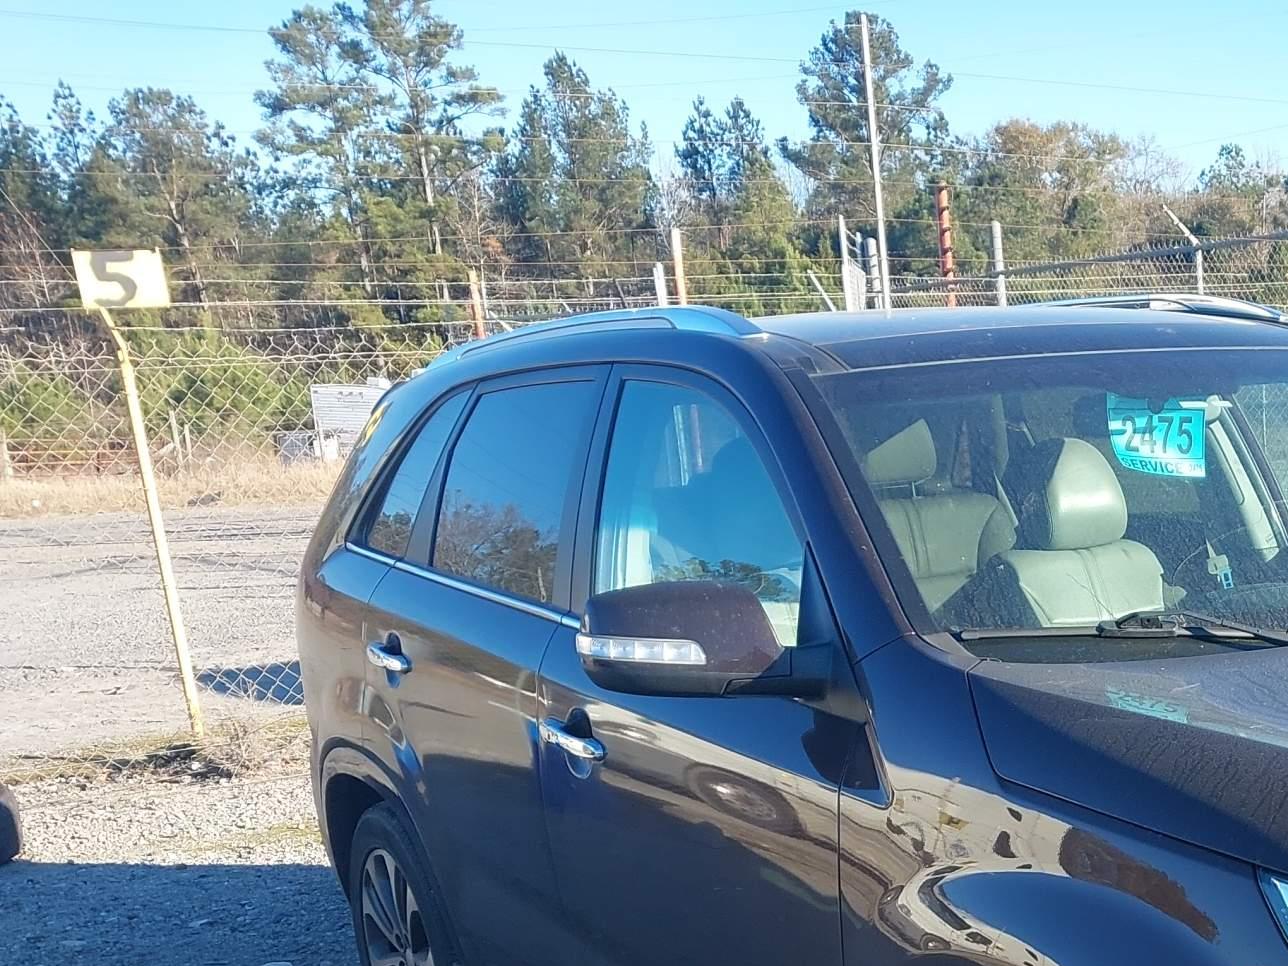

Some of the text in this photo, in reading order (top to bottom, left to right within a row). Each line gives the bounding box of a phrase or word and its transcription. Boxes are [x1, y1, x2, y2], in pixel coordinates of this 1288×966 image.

[89, 251, 138, 307] 5
[1121, 414, 1193, 455] 2475
[1121, 457, 1185, 474] SERVICE
